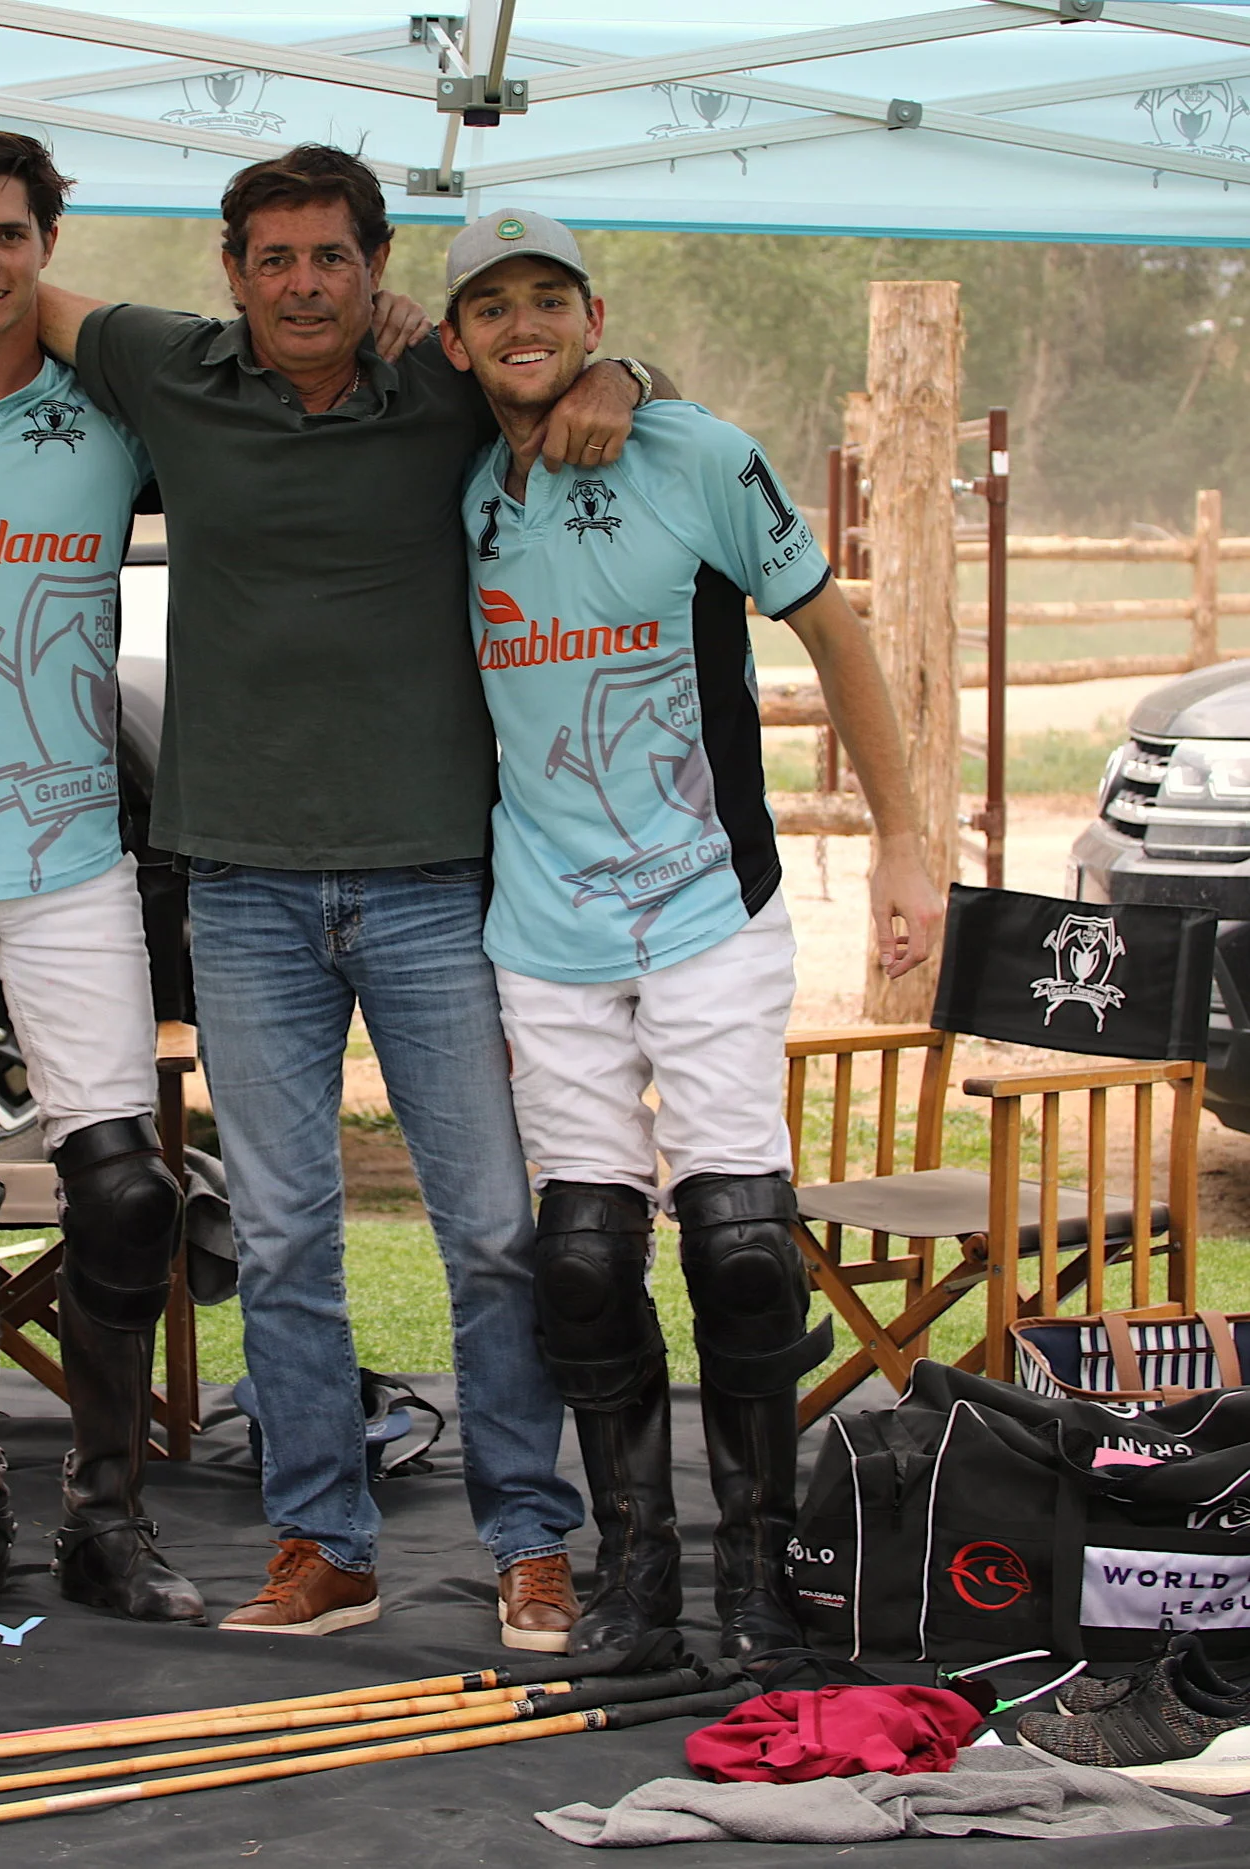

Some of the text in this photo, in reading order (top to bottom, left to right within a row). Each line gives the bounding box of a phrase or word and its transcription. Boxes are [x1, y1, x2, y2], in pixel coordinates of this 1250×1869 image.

[737, 448, 798, 544] 1
[667, 690, 701, 713] POL
[35, 774, 92, 803] Grand
[633, 852, 694, 890] Grand
[1102, 1565, 1230, 1589] WORLD
[1160, 1595, 1250, 1616] LEAGU
